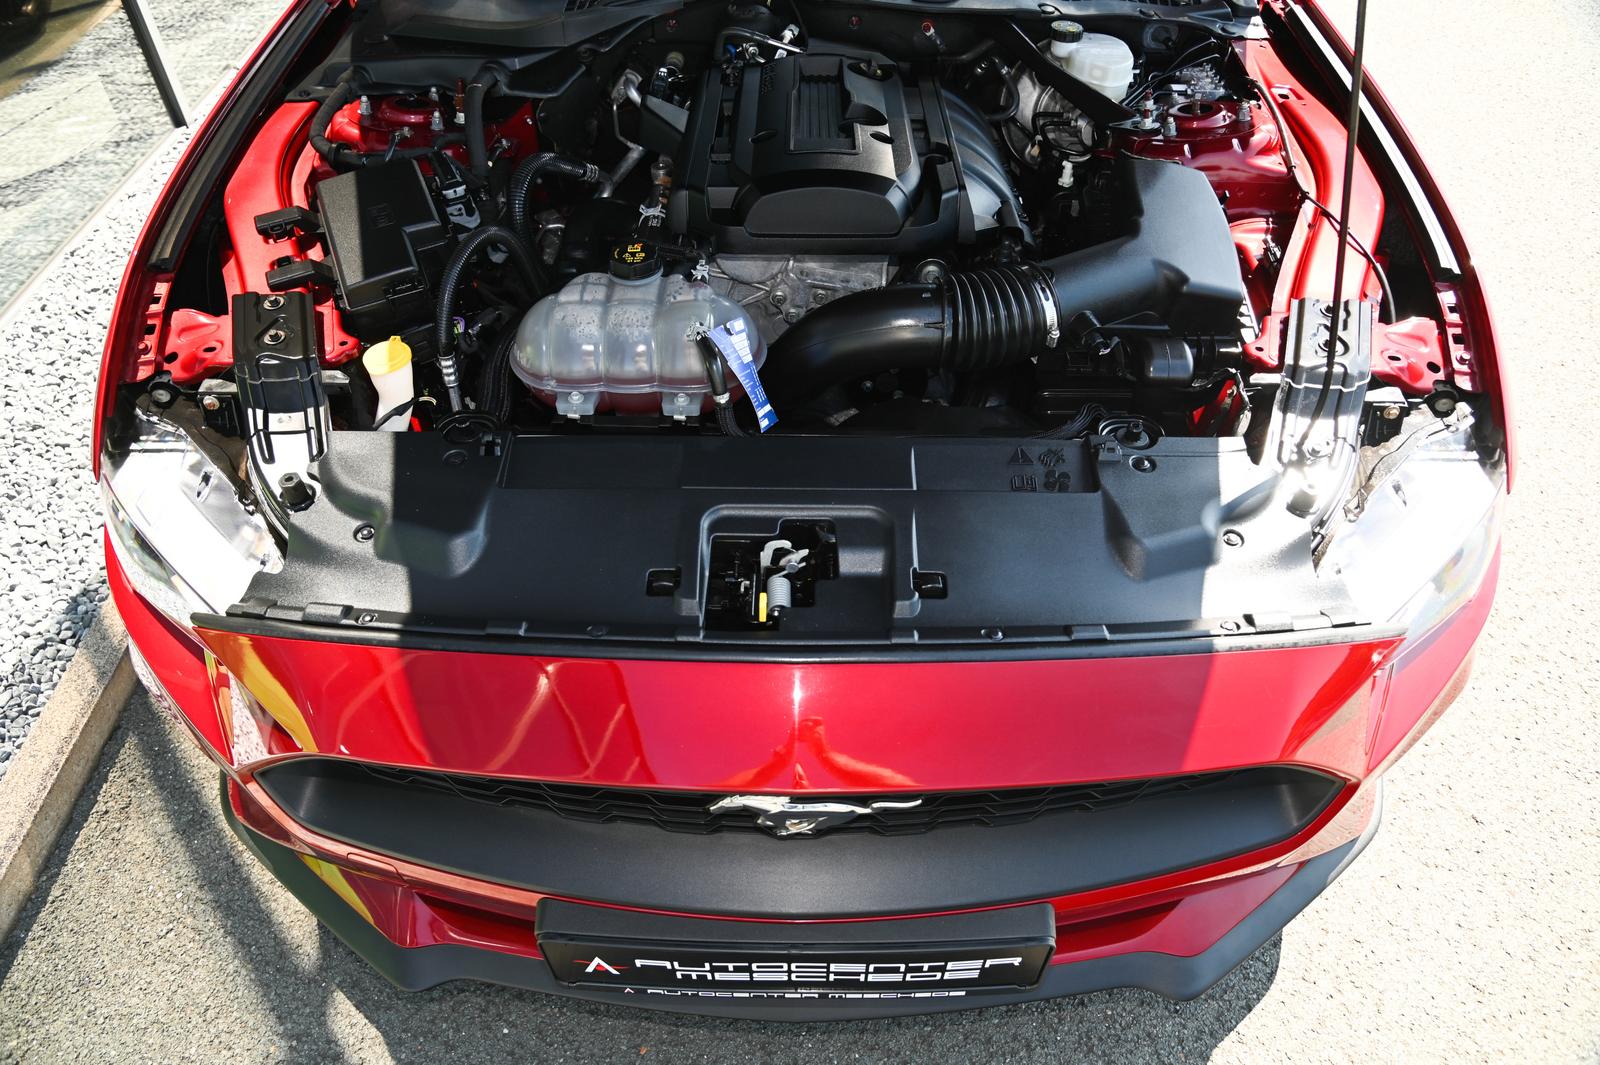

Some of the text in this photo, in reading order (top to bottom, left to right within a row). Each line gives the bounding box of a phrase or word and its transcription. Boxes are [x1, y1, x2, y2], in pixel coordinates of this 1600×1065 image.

[634, 957, 1023, 972] AUTOCENTER
[675, 969, 982, 982] MESCHEDE
[647, 988, 819, 998] AUTOCENTER
